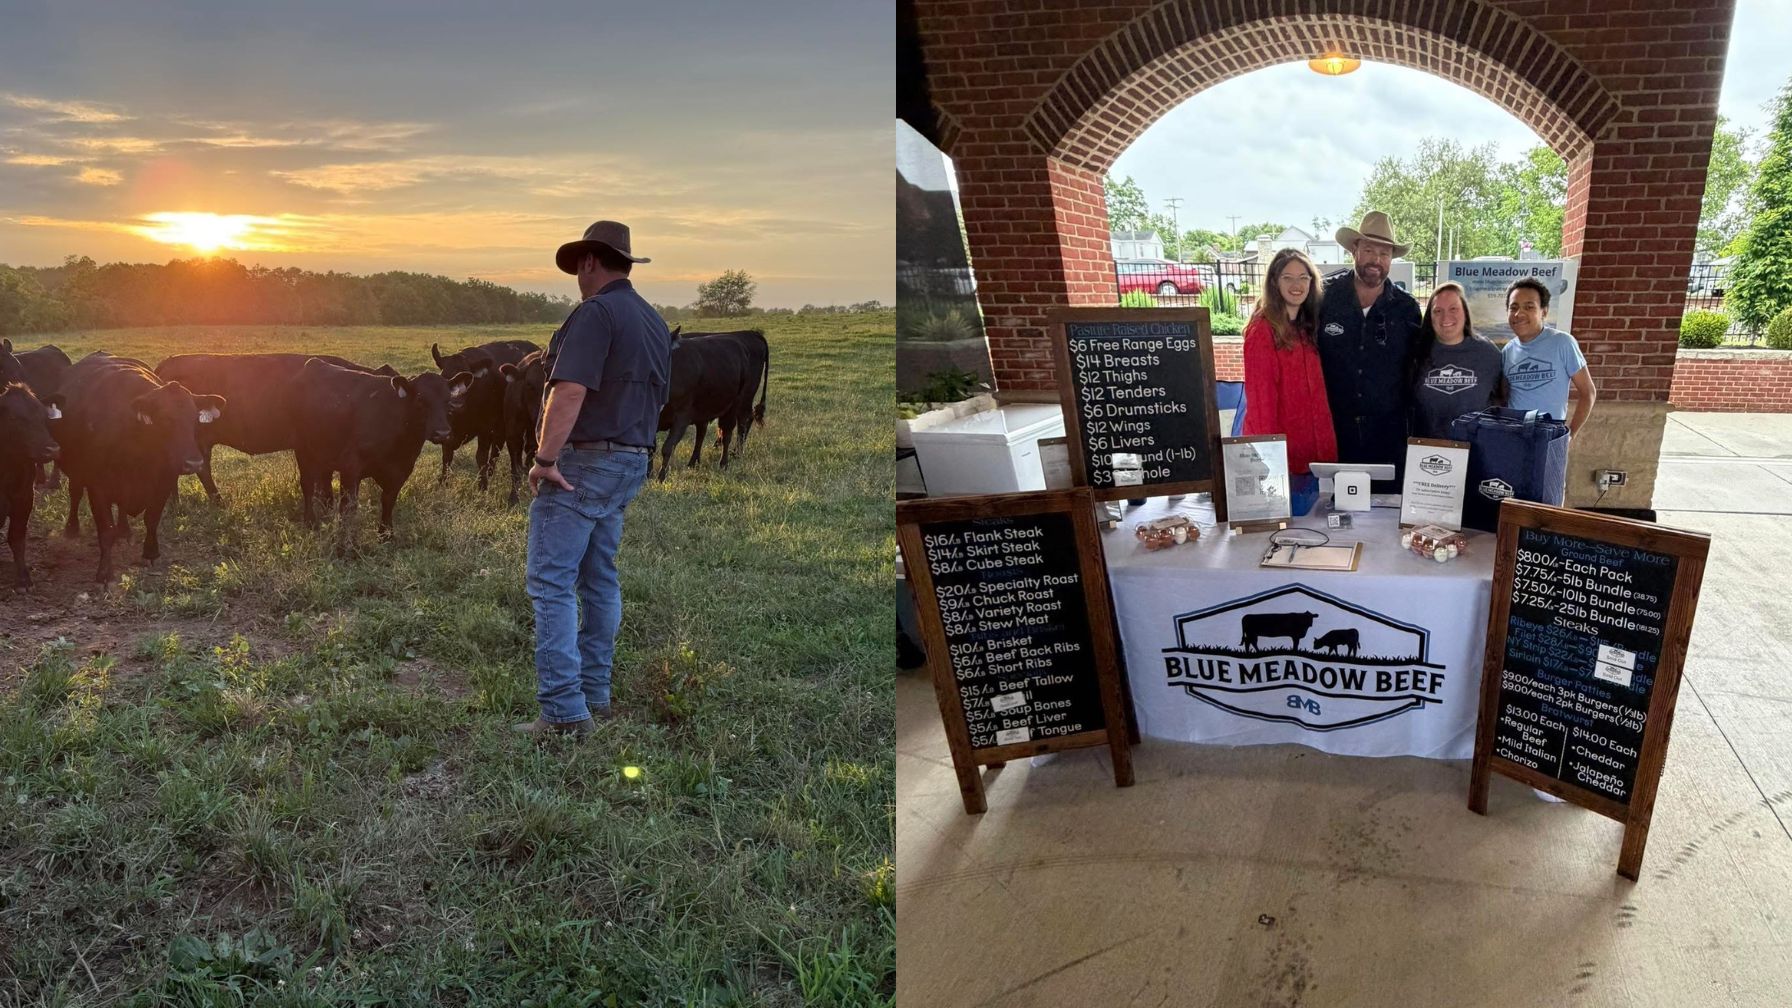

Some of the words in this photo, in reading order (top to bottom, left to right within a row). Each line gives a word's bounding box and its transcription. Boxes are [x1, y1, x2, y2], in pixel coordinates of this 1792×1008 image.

[1456, 267, 1478, 276] Blue
[1482, 267, 1528, 276] Meadow
[1532, 267, 1557, 276] Beef
[1113, 323, 1148, 336] Raised
[1150, 322, 1190, 334] Chicken
[1069, 338, 1087, 353] $6
[1090, 339, 1120, 351] Free
[1122, 338, 1163, 352] Range
[1166, 337, 1196, 351] Eggs
[1076, 353, 1101, 369] $14
[1104, 354, 1160, 367] Breasts
[1079, 370, 1101, 385] $12
[1102, 369, 1148, 384] Thighs
[1081, 385, 1105, 402] $12
[1106, 385, 1166, 399] Tenders
[1084, 403, 1103, 419] $6
[1106, 401, 1187, 417] Drumsticks
[1087, 420, 1107, 435] $12
[1109, 420, 1151, 434] Wings
[1089, 436, 1108, 452] $6
[1111, 436, 1155, 449] Livers
[1141, 465, 1170, 479] hole
[964, 530, 1003, 544] Flank
[1004, 526, 1044, 538] Steak
[966, 544, 999, 557] Skirt
[1002, 540, 1040, 554] Steak
[1525, 530, 1551, 544] Buy
[1633, 551, 1670, 566] More
[966, 559, 1002, 571] Cube
[1005, 554, 1044, 566] Steak
[1561, 548, 1597, 562] Ground
[1599, 555, 1624, 568] Beef
[979, 577, 1041, 594] Specialty
[1043, 572, 1079, 586] Roast
[1600, 566, 1633, 584] Pack
[1586, 578, 1632, 598] Bundle
[972, 592, 1016, 607] Chuck
[1018, 588, 1054, 601] Roast
[1589, 594, 1636, 615] Bundle
[975, 605, 1024, 620] Variety
[1026, 600, 1062, 613] Roast
[979, 619, 1013, 632] Stew
[1015, 614, 1049, 627] Meat
[1510, 614, 1544, 632] Ribeye
[1553, 616, 1599, 636] Steaks
[1589, 610, 1636, 630] Bundle
[987, 635, 1032, 650] Brisket
[1514, 627, 1537, 641] Filet
[986, 649, 1017, 663] Beef
[1020, 646, 1052, 658] Back
[1054, 642, 1080, 653] Ribs
[1507, 636, 1520, 647] NY
[1522, 639, 1546, 656] Strip
[988, 661, 1023, 675] Short
[1026, 658, 1052, 669] Ribs
[1509, 649, 1541, 666] Sirloin
[999, 677, 1030, 692] Beef
[1032, 674, 1074, 686] Tallow
[1164, 656, 1232, 684] BLUE
[1238, 656, 1367, 692] MEADOW
[1376, 669, 1446, 694] BEEF
[1536, 668, 1574, 686] Burger
[1575, 680, 1612, 699] Patties
[1502, 670, 1556, 693] $9.00/each
[1558, 686, 1576, 700] 3pk
[1502, 680, 1554, 703] $9.00/each
[1556, 696, 1574, 710] 2pk
[1000, 704, 1032, 716] Soup
[1034, 699, 1072, 712] Bones
[1541, 702, 1594, 728] Bratwurst
[1003, 715, 1034, 729] Beef
[1036, 712, 1067, 724] Liver
[1506, 704, 1538, 722] $13.00
[1540, 715, 1566, 732] Each
[1040, 724, 1082, 736] Tongue
[1522, 731, 1548, 747] Beef
[1572, 726, 1608, 746] $14.00
[1609, 740, 1638, 758] Each
[1524, 744, 1557, 763] Italian
[1577, 771, 1626, 797] Cheddar
